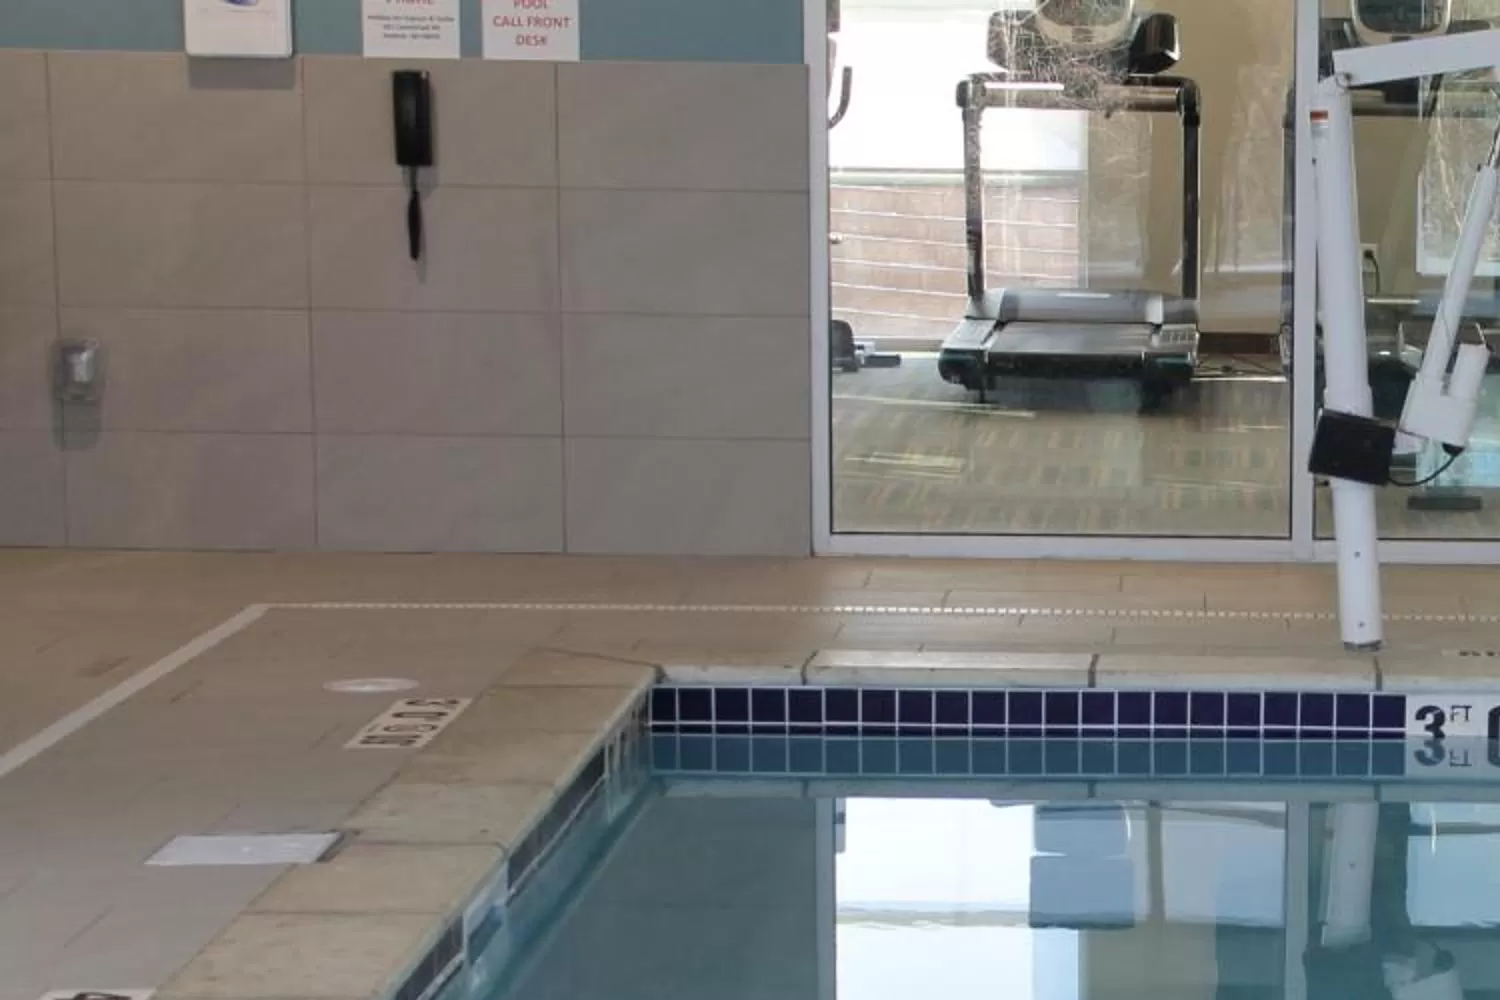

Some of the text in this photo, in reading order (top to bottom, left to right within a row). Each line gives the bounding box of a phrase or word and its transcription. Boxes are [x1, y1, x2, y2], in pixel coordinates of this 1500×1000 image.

[492, 15, 572, 29] CALL FRONT
[515, 35, 547, 47] DESK
[1414, 704, 1446, 748] 3
[1450, 704, 1473, 723] FT
